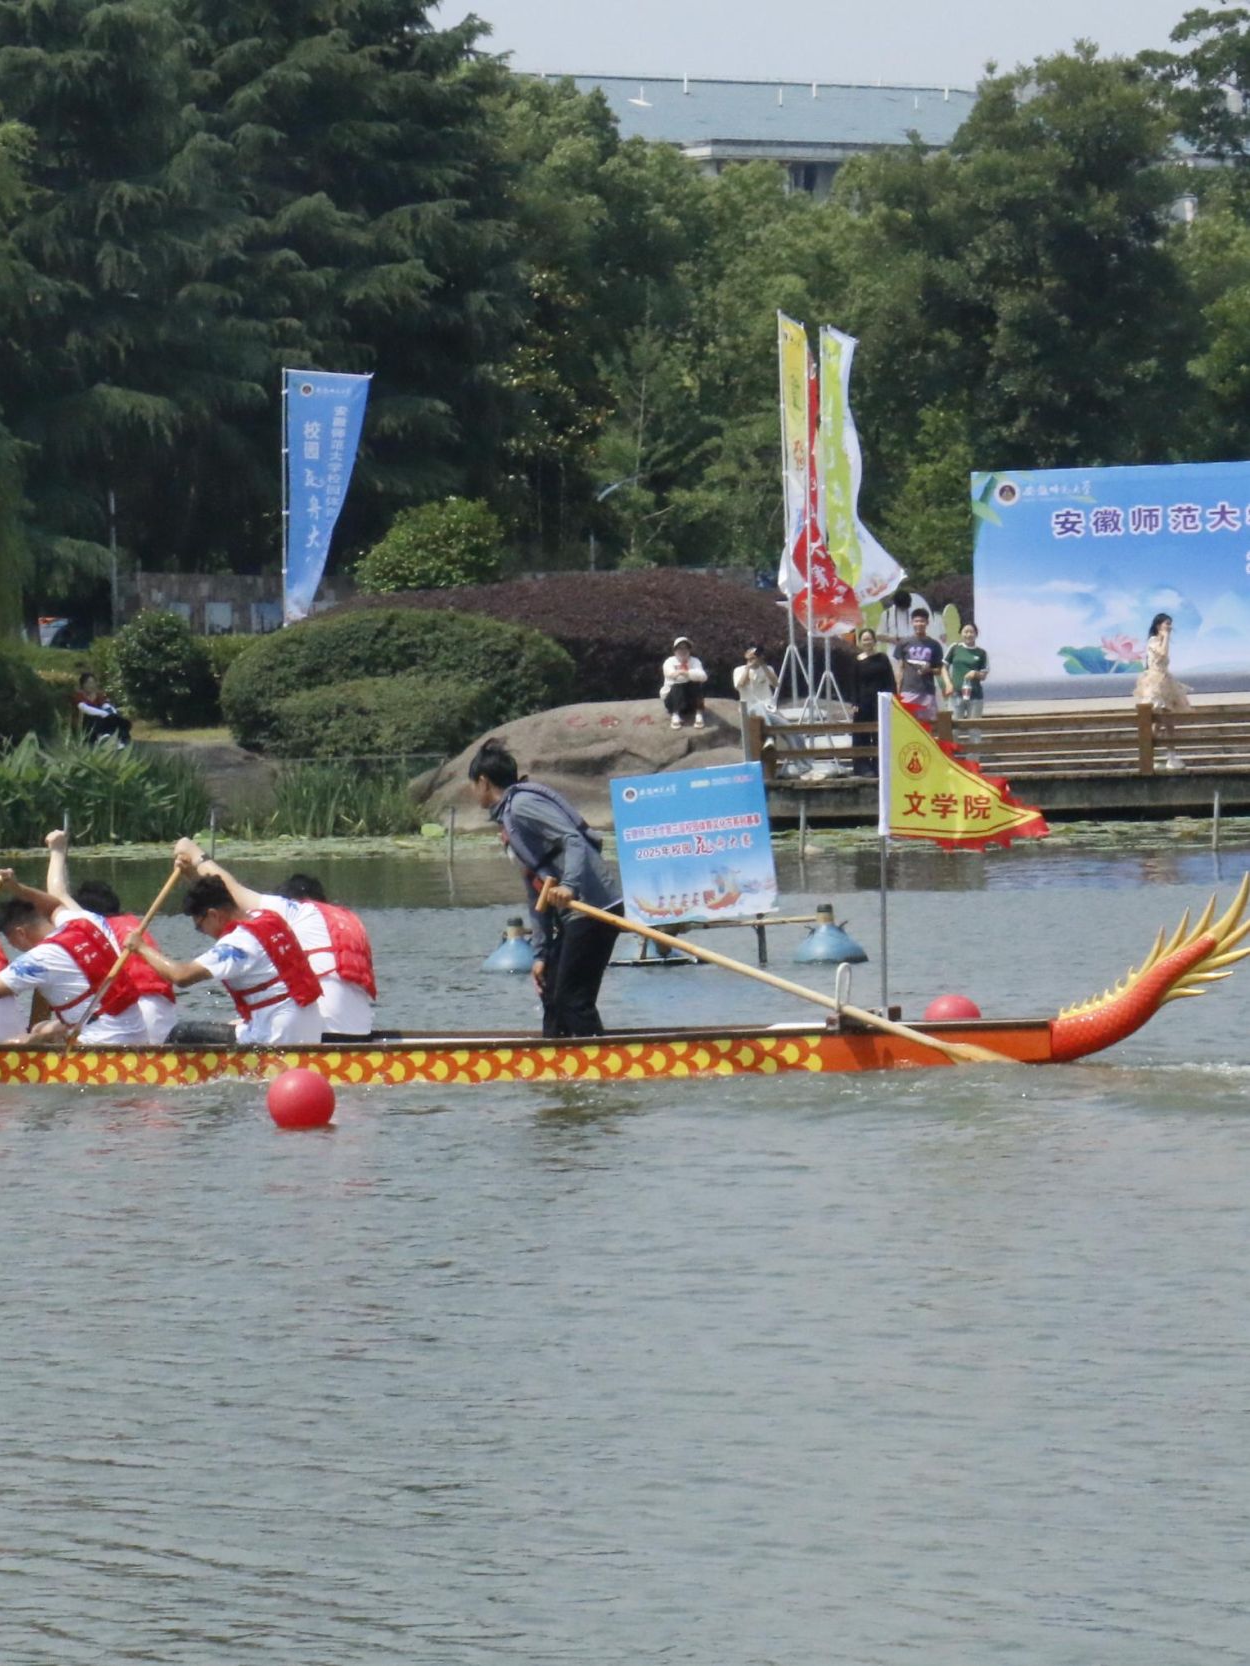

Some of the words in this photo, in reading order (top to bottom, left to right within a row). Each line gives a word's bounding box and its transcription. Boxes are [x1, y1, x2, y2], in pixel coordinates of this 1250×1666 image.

[1053, 502, 1250, 537] 安徽师范大
[902, 791, 991, 820] 文学院
